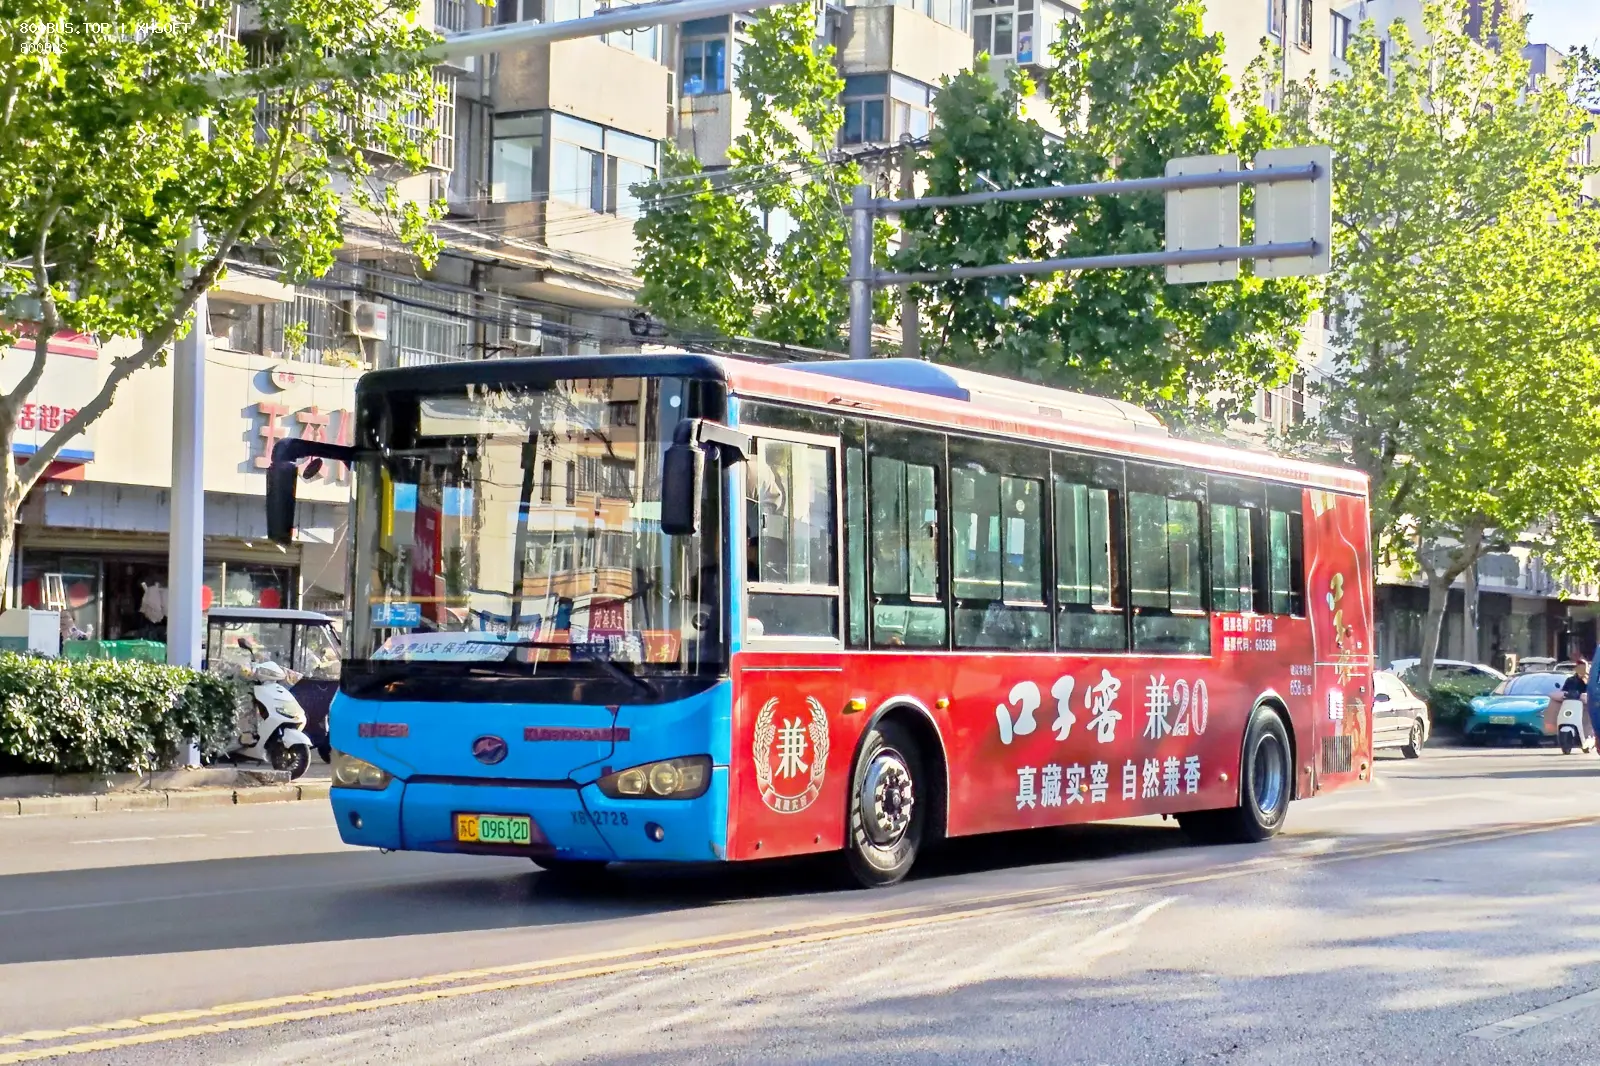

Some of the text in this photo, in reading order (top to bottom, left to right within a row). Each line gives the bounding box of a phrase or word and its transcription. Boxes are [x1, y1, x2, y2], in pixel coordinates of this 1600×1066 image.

[996, 668, 1208, 744] 口子窖 兼20
[775, 717, 808, 779] 兼
[1016, 755, 1200, 810] 真藏实窖 自然兼香
[481, 820, 529, 840] 09612D
[594, 811, 629, 826] 2728
